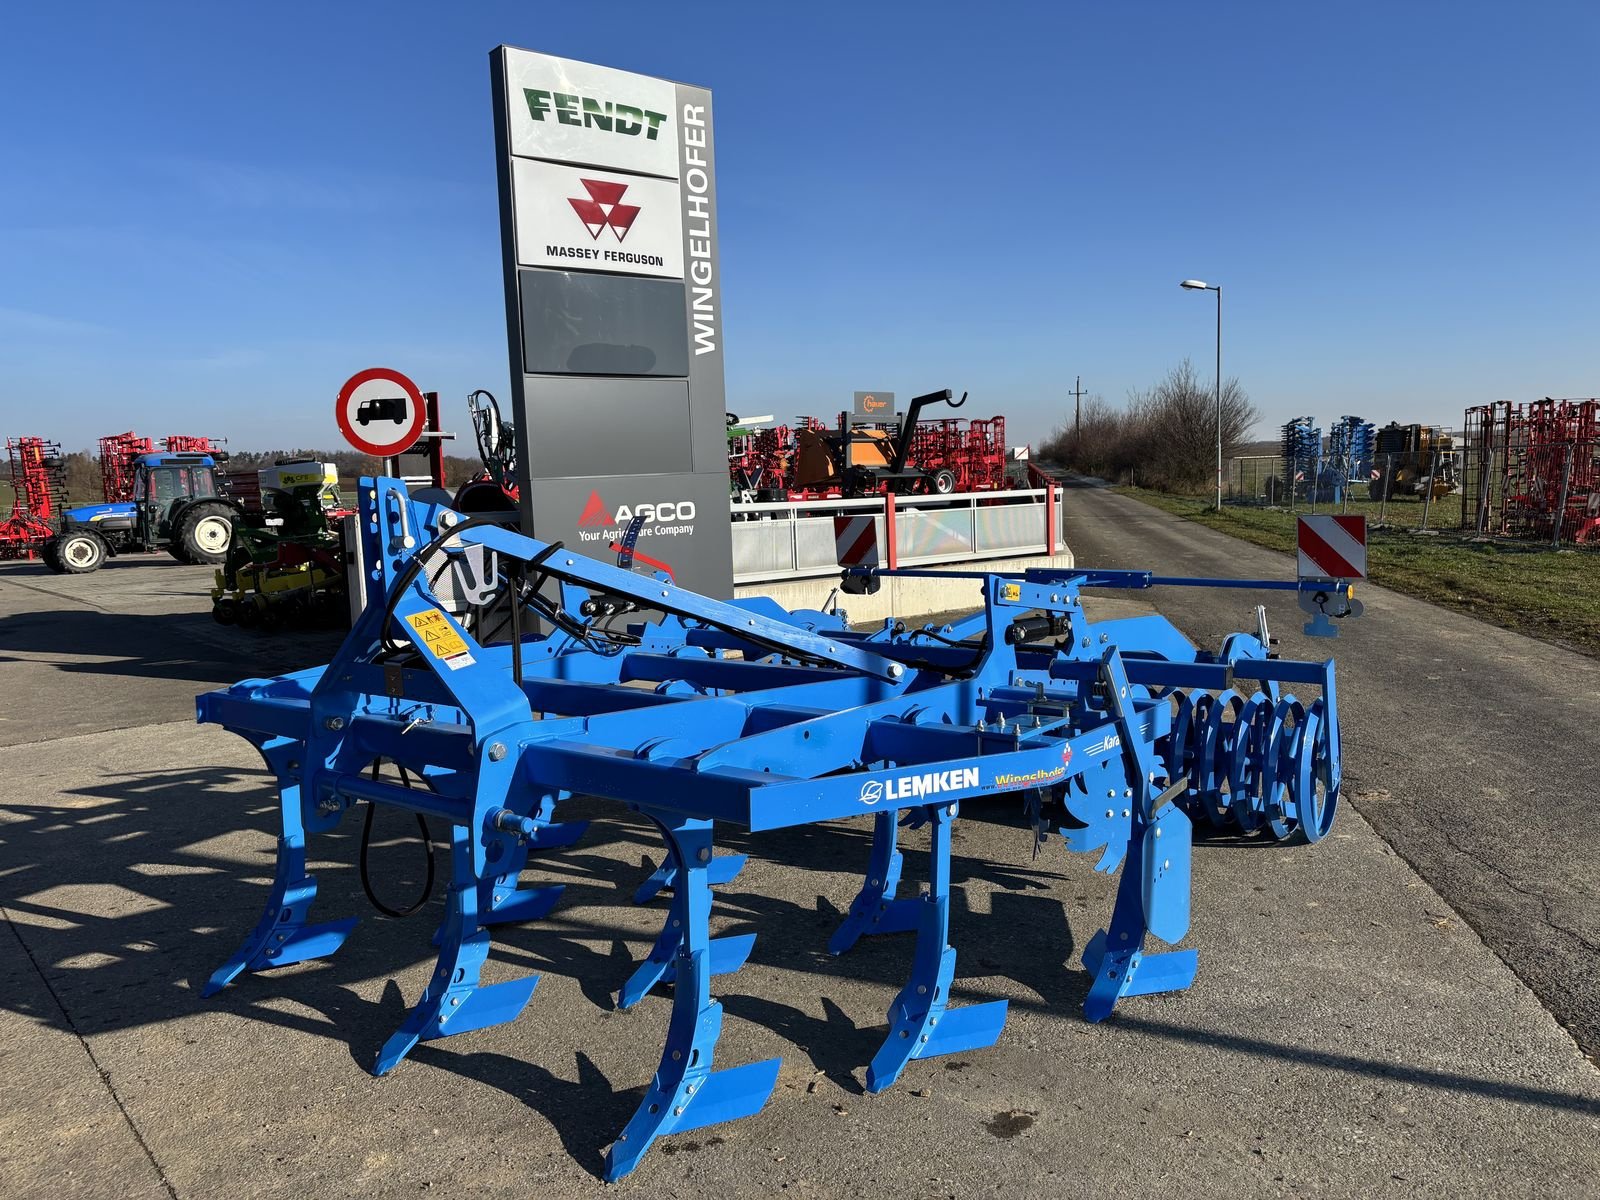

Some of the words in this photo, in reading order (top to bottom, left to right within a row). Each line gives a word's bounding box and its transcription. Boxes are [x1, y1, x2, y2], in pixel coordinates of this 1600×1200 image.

[523, 87, 667, 141] FENDT
[683, 103, 716, 356] WINGELHOFER
[546, 245, 600, 260] MASSEY
[604, 250, 664, 267] FERGUSON
[614, 501, 696, 524] AGCO
[579, 530, 600, 542] Your
[602, 526, 653, 541] Agricure
[655, 525, 694, 536] Company
[885, 766, 979, 800] LEMKEN
